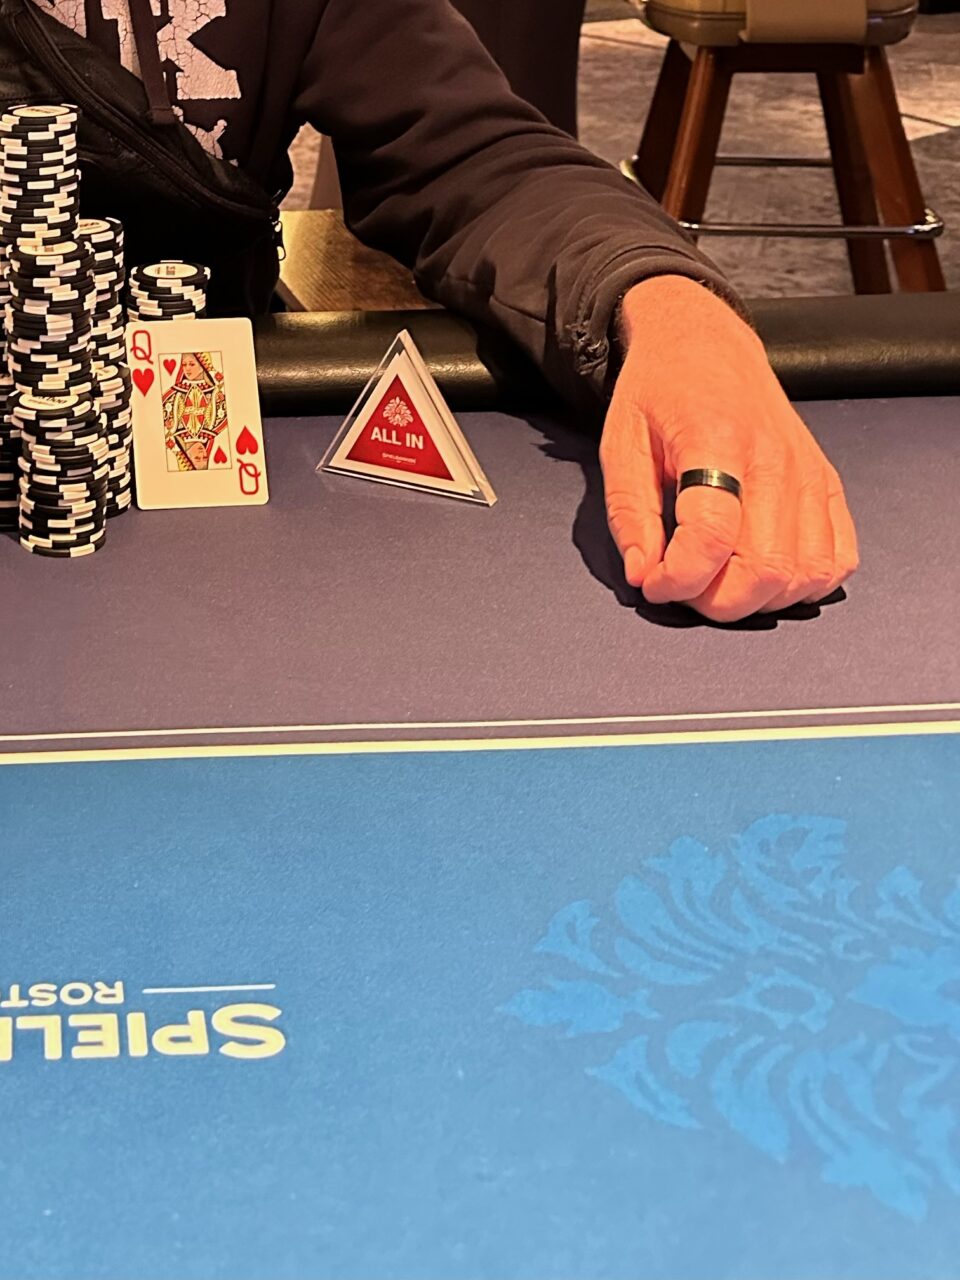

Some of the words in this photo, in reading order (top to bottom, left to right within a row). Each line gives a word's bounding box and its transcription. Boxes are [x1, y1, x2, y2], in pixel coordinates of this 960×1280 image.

[130, 330, 154, 365] Q
[370, 426, 402, 446] ALL
[405, 432, 424, 450] IN
[236, 458, 261, 496] Q
